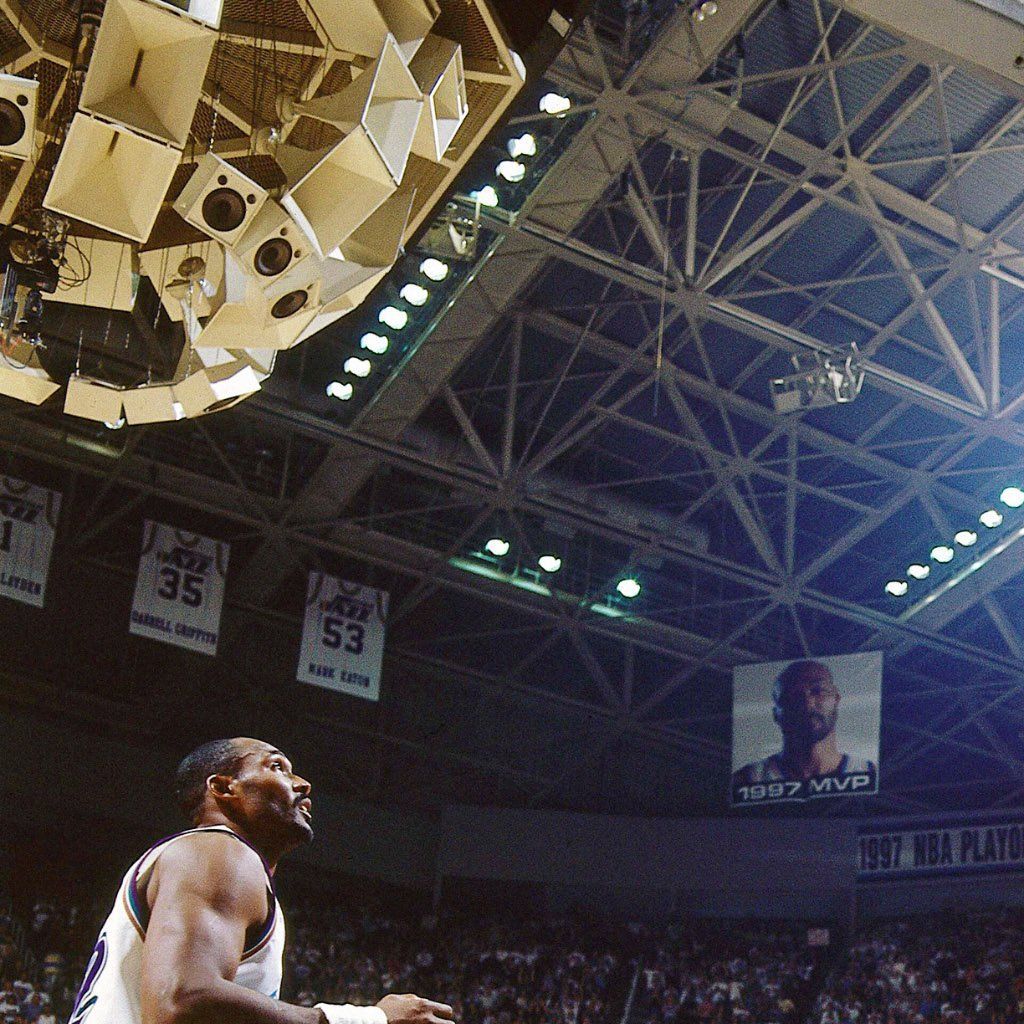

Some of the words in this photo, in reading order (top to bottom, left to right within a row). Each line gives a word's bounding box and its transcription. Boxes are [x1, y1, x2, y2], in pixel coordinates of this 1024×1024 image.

[157, 566, 204, 608] 35
[321, 616, 365, 656] 53
[739, 781, 802, 800] 1997
[810, 775, 870, 792] MVP
[859, 835, 902, 871] 1997
[913, 831, 953, 867] NBA
